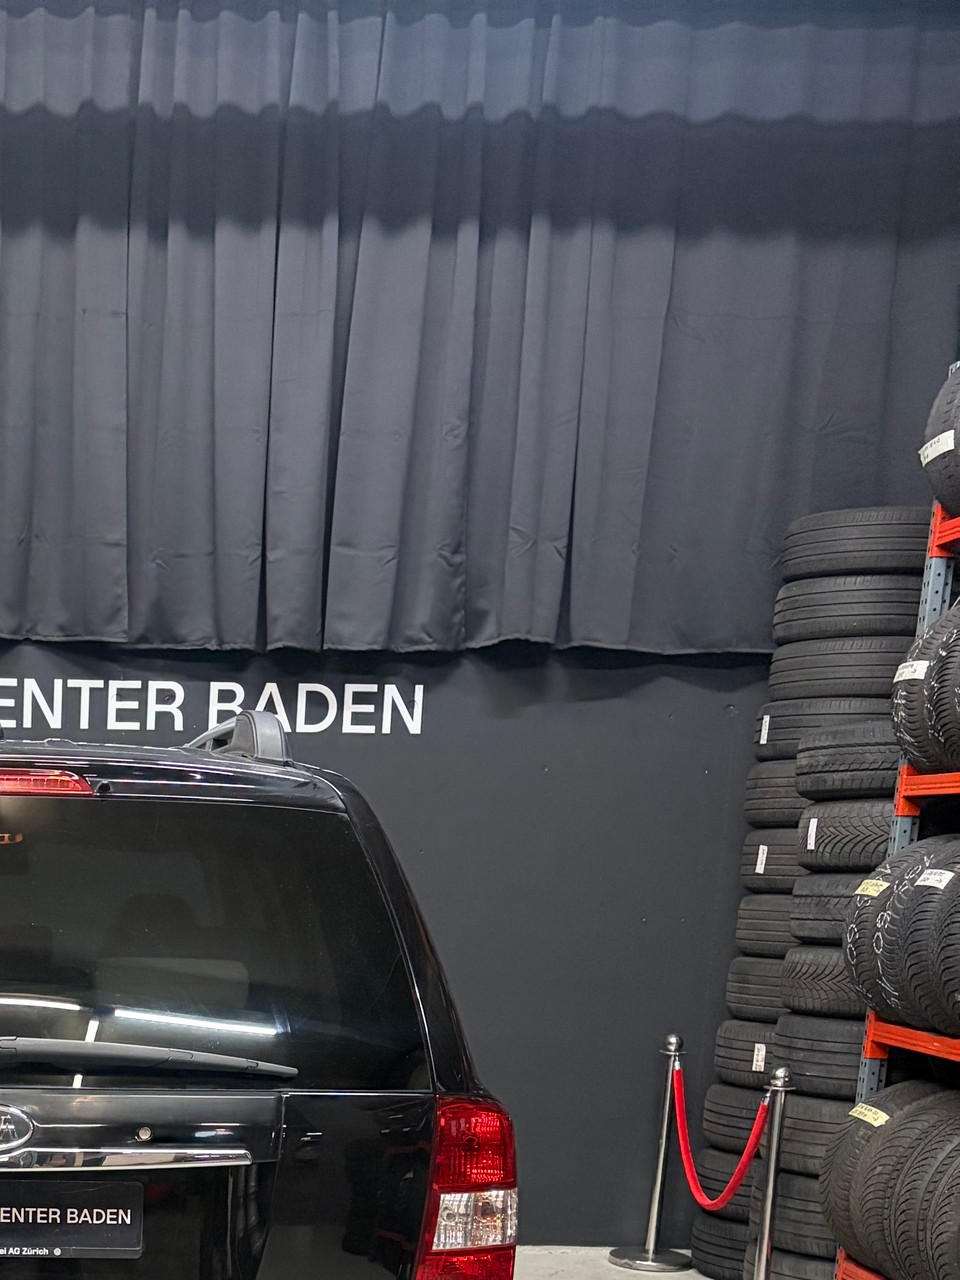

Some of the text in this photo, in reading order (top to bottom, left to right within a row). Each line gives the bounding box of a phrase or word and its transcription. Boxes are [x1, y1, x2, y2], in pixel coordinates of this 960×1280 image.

[208, 681, 424, 734] BADEN
[66, 1208, 131, 1225] BADEN
[8, 1247, 21, 1256] AG
[22, 1247, 49, 1256] Zürich
